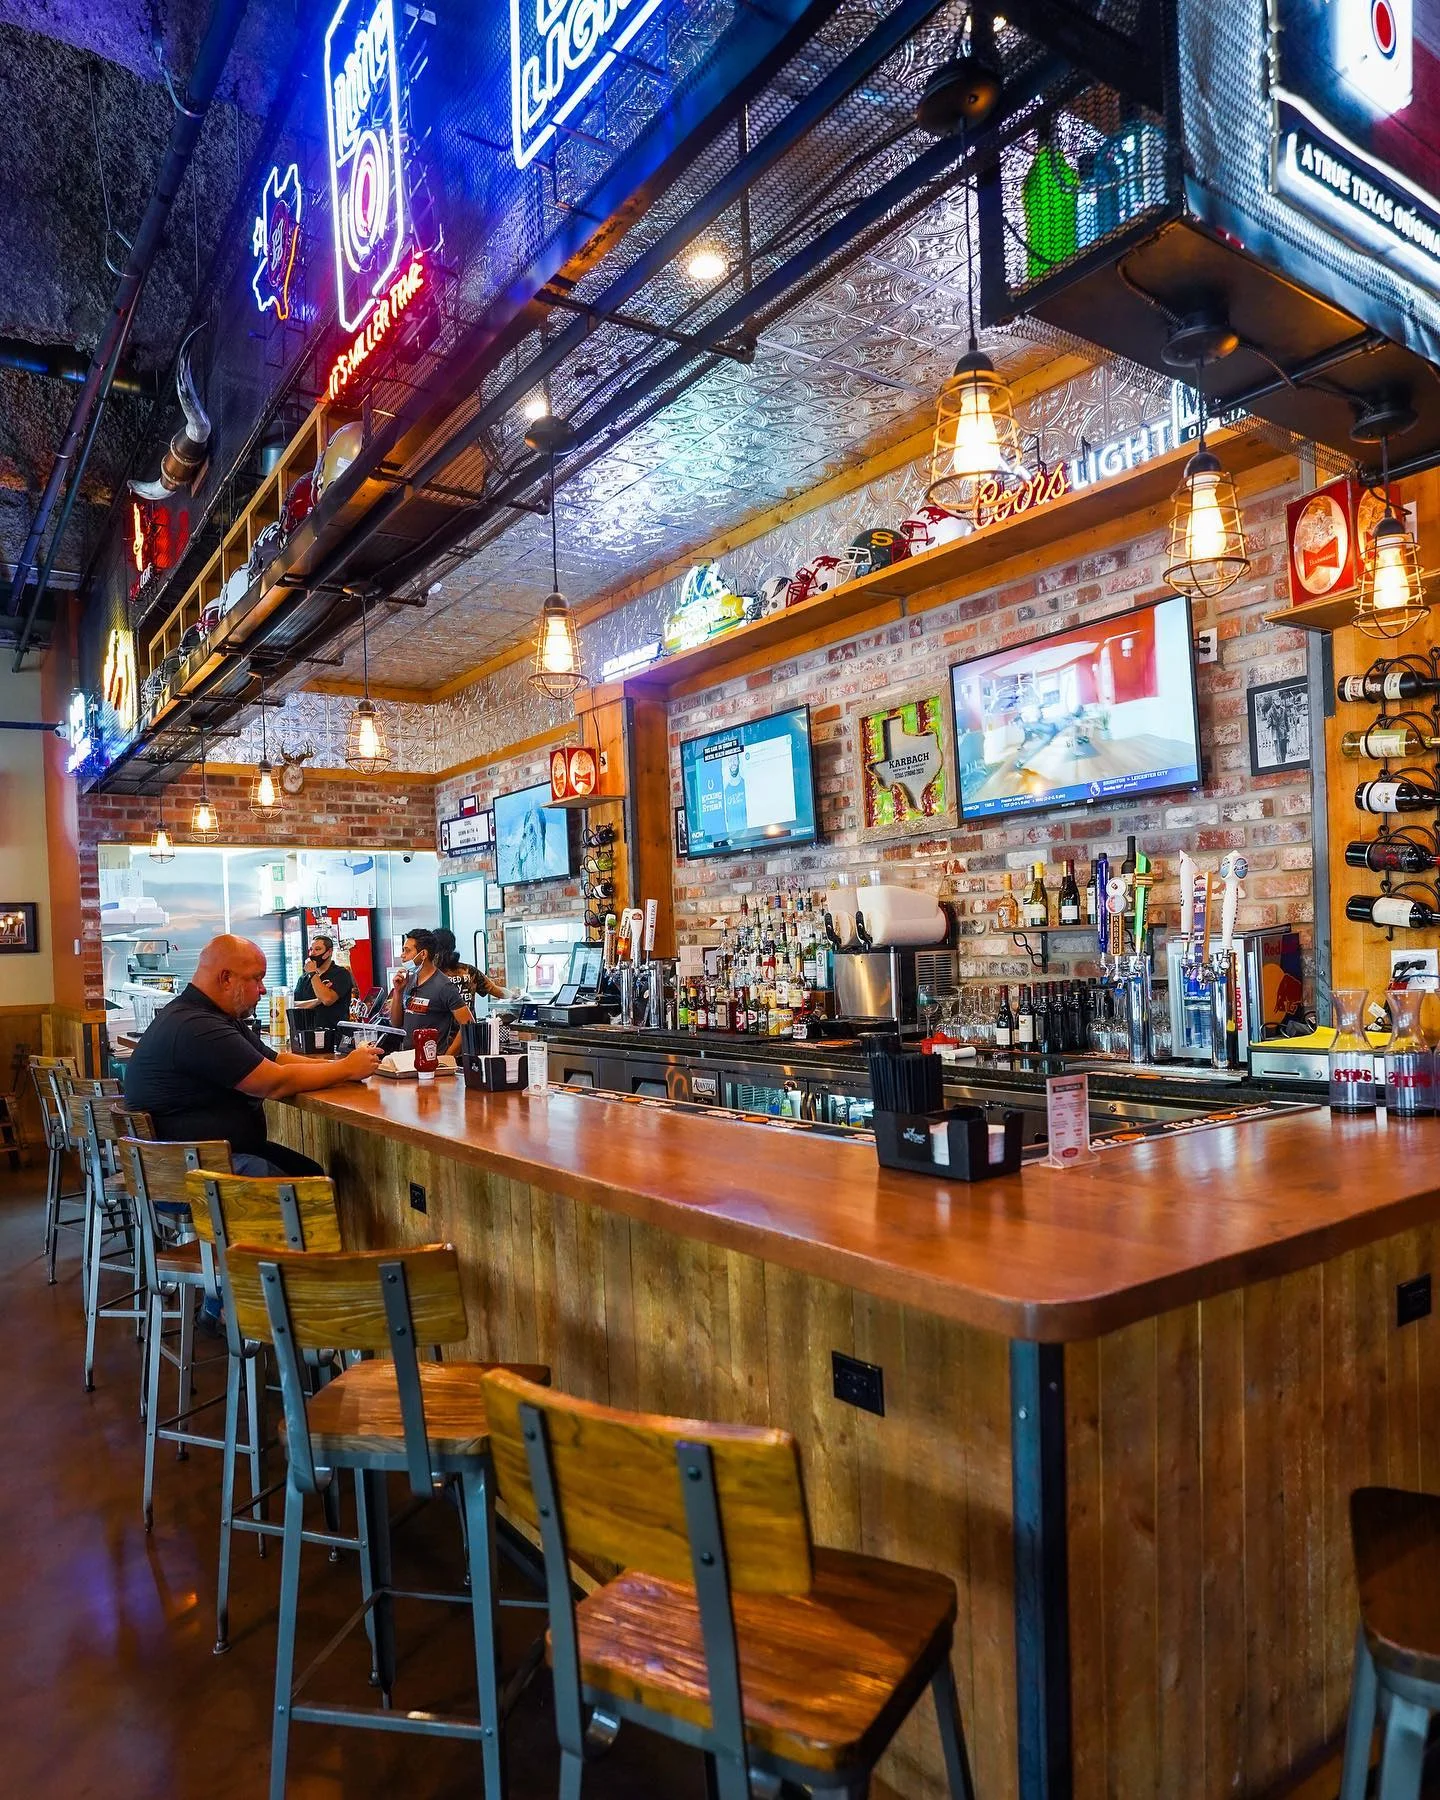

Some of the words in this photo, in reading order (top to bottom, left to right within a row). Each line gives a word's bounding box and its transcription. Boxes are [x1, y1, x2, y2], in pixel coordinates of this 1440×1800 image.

[1301, 143, 1314, 171] A
[1313, 148, 1351, 195] TRUE
[1351, 175, 1394, 223] TEXAS
[390, 262, 424, 319] TIME
[974, 463, 1072, 530] Coors
[1071, 419, 1171, 490] LIGHT
[889, 752, 930, 769] KARBACH
[1264, 942, 1281, 956] Red
